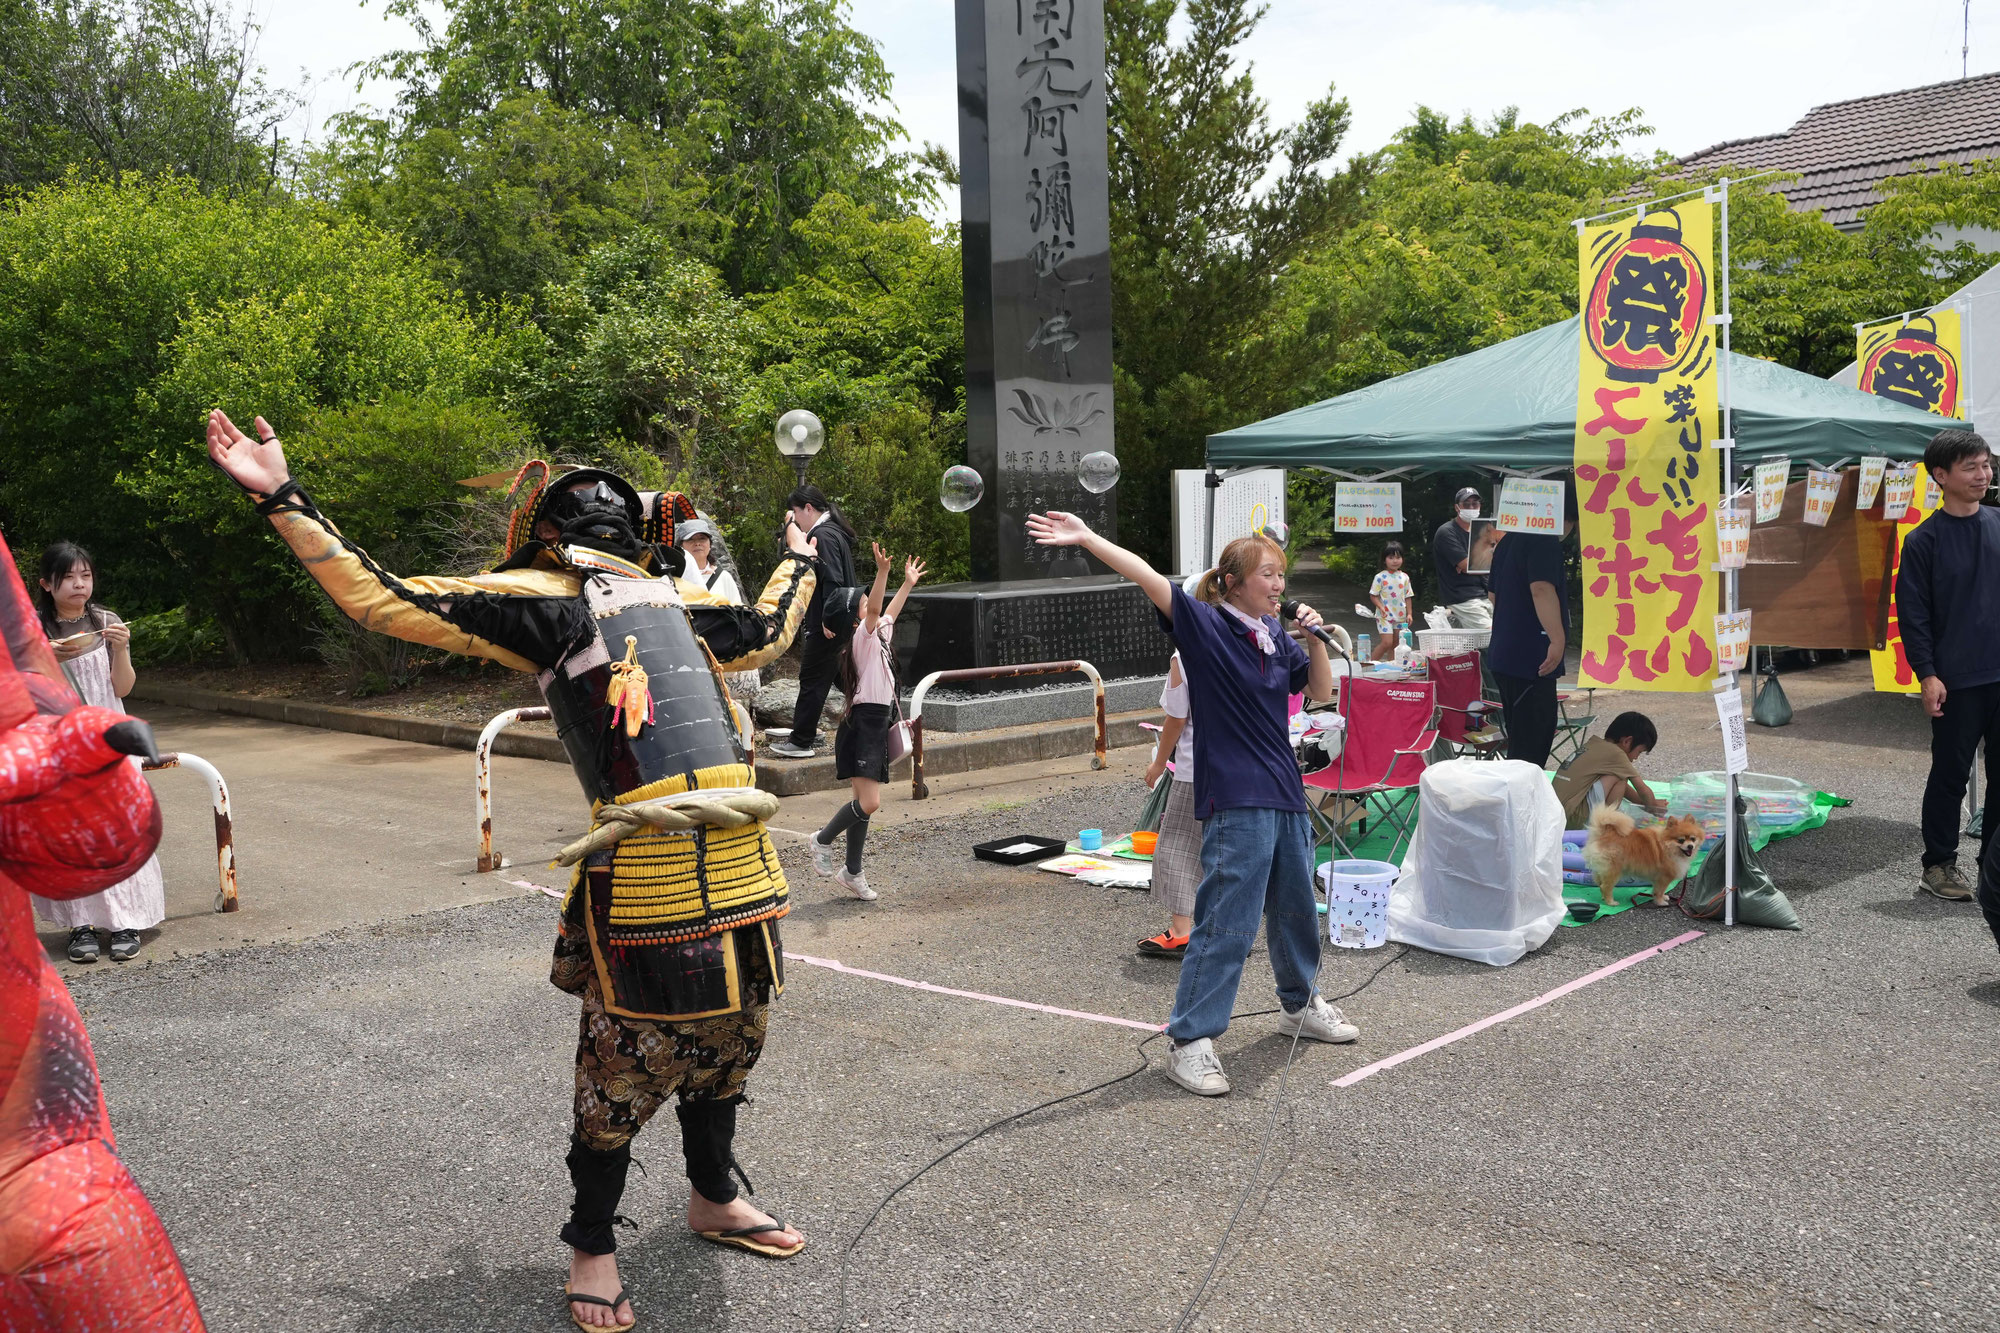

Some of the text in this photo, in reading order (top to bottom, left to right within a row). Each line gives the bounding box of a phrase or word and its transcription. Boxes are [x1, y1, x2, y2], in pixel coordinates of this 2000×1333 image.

[1338, 516, 1394, 527] 15分 100円
[1500, 513, 1555, 529] 15分 100円
[1386, 689, 1412, 698] CAPTAIN
